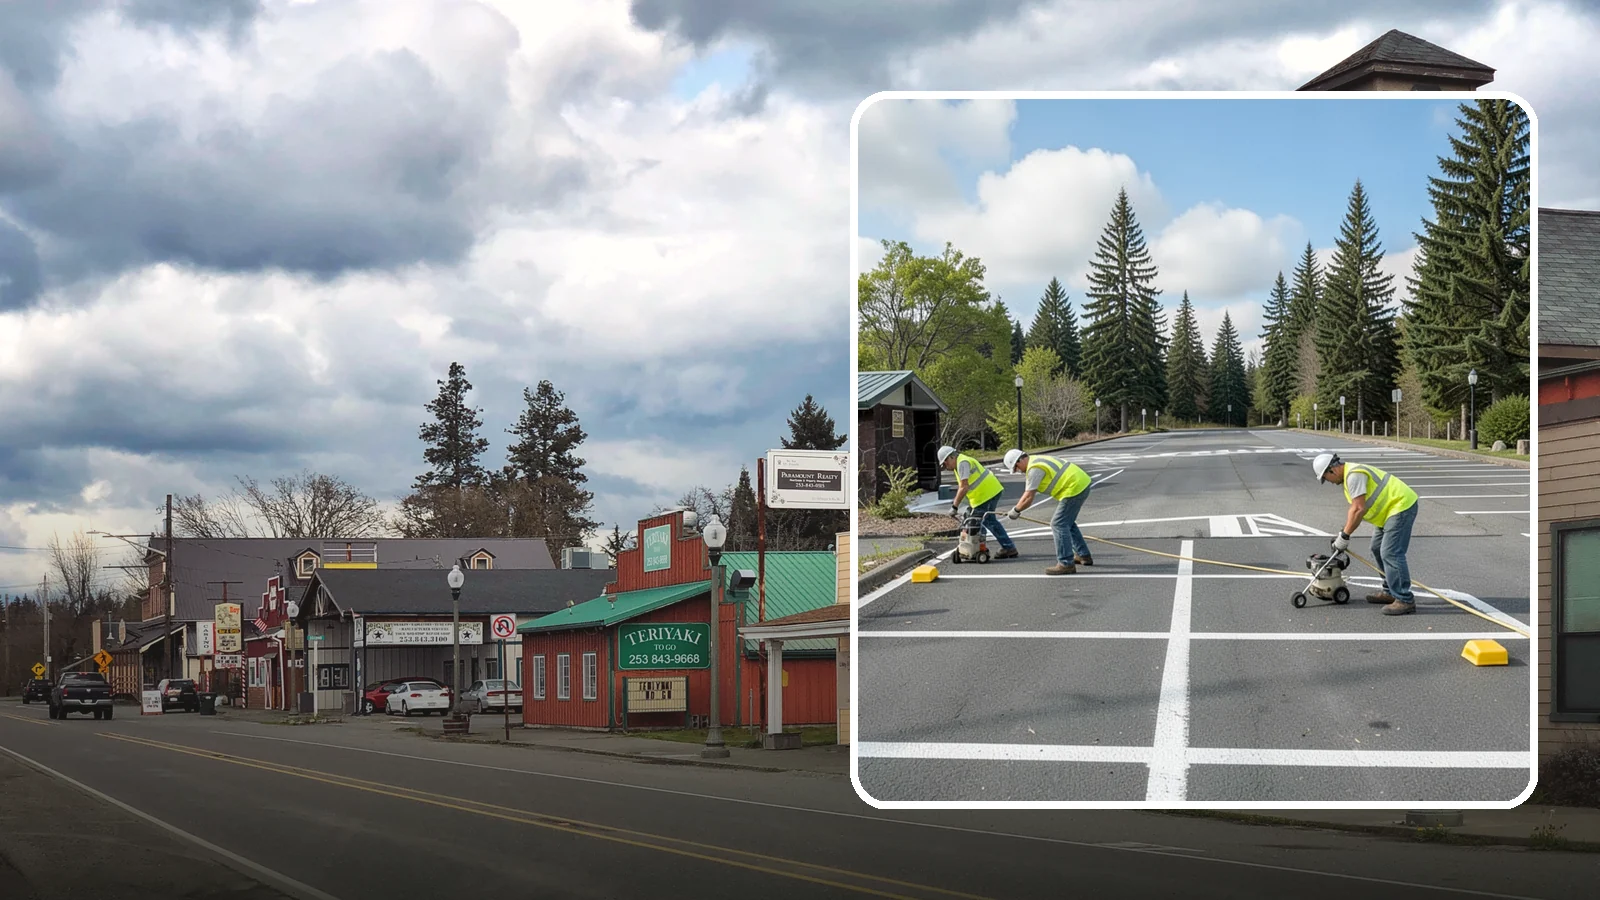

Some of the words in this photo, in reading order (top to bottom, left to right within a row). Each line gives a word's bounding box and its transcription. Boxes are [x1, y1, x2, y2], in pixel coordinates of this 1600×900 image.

[625, 628, 702, 646] TERIYAKI
[629, 654, 648, 664] 253
[652, 654, 700, 664] 843-9668
[639, 681, 672, 690] TERIYAKI
